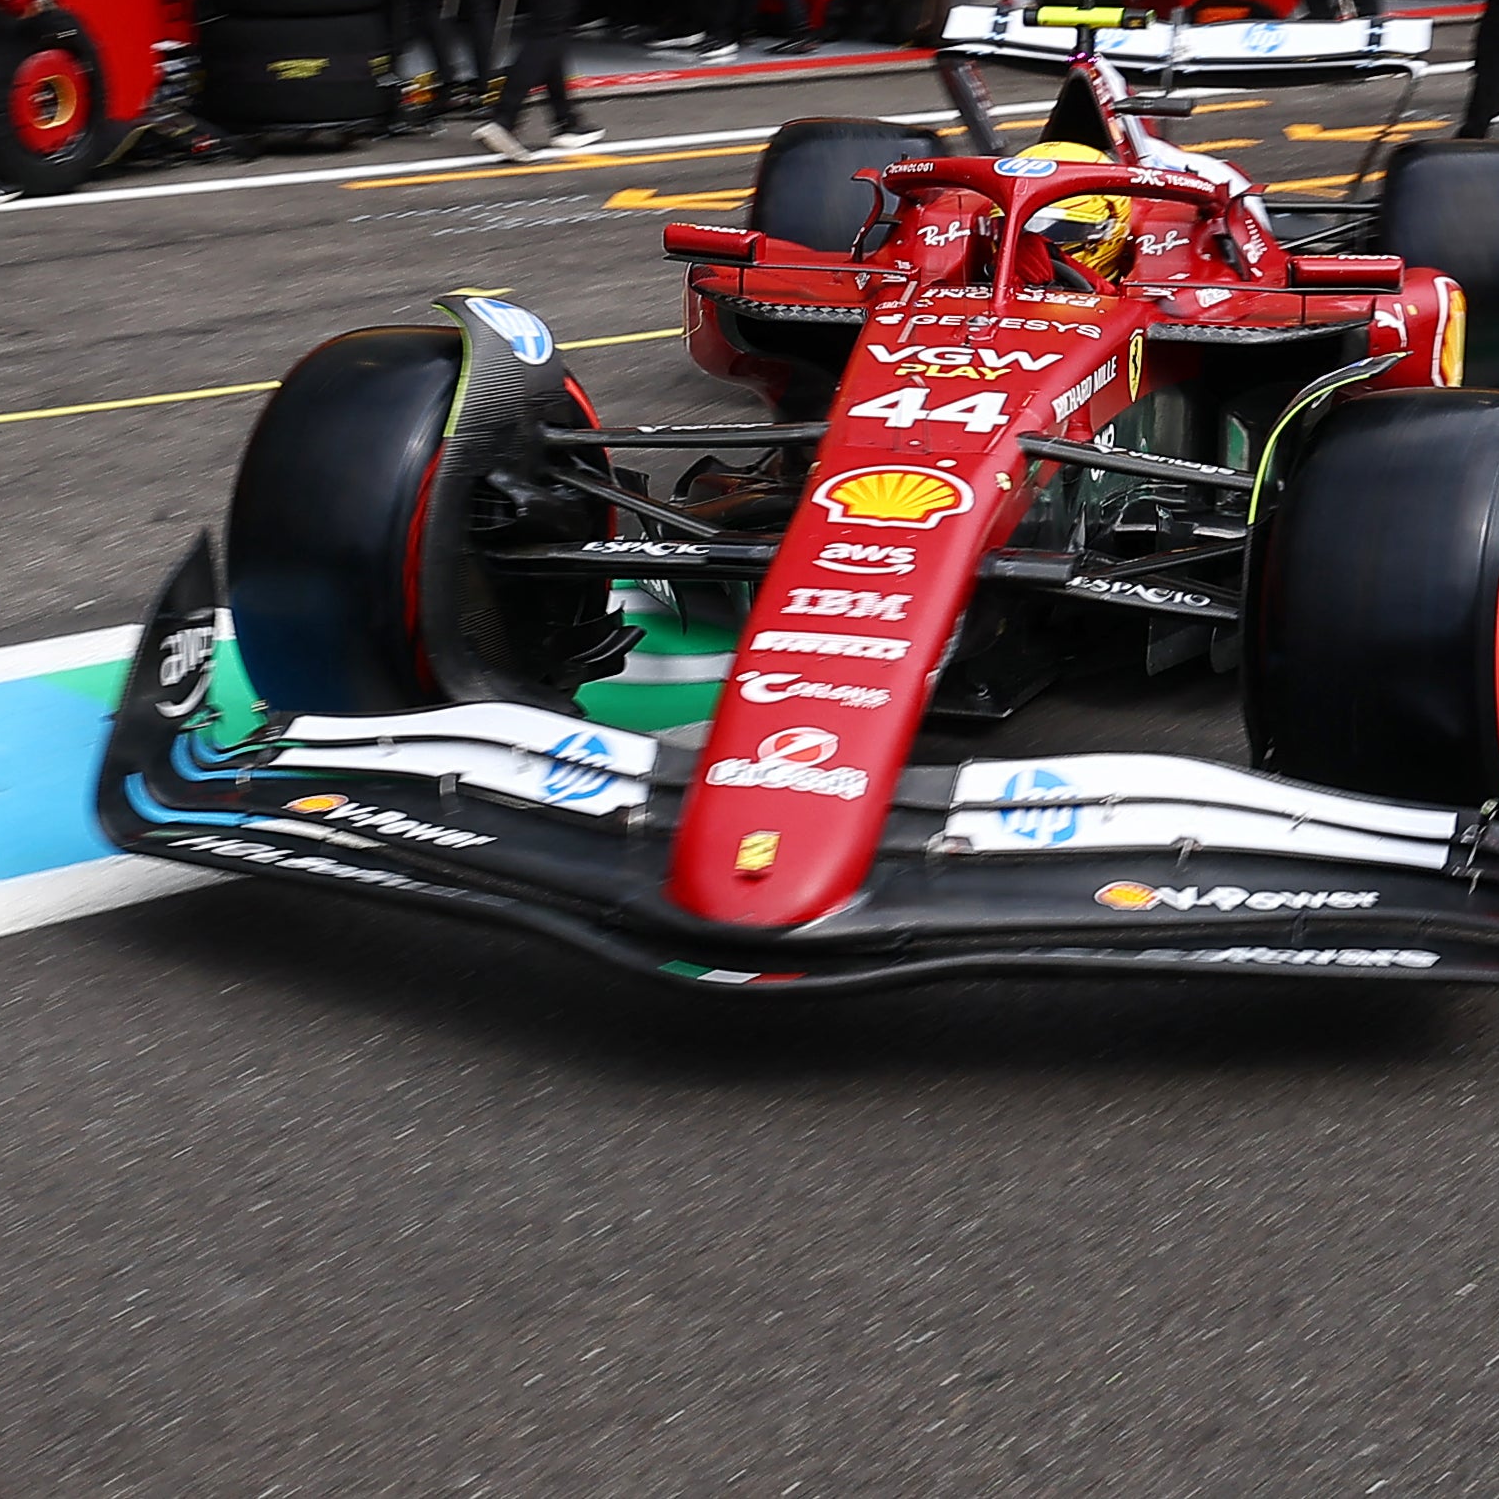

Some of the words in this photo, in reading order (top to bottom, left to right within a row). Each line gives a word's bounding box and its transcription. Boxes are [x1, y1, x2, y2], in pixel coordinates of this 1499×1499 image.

[867, 344, 1064, 371] VGW
[894, 363, 1012, 380] PLAY
[847, 387, 1010, 433] 44
[819, 543, 916, 565] aws
[780, 588, 914, 621] IBM
[750, 631, 912, 661] PIRELLI
[324, 802, 498, 849] V-Power
